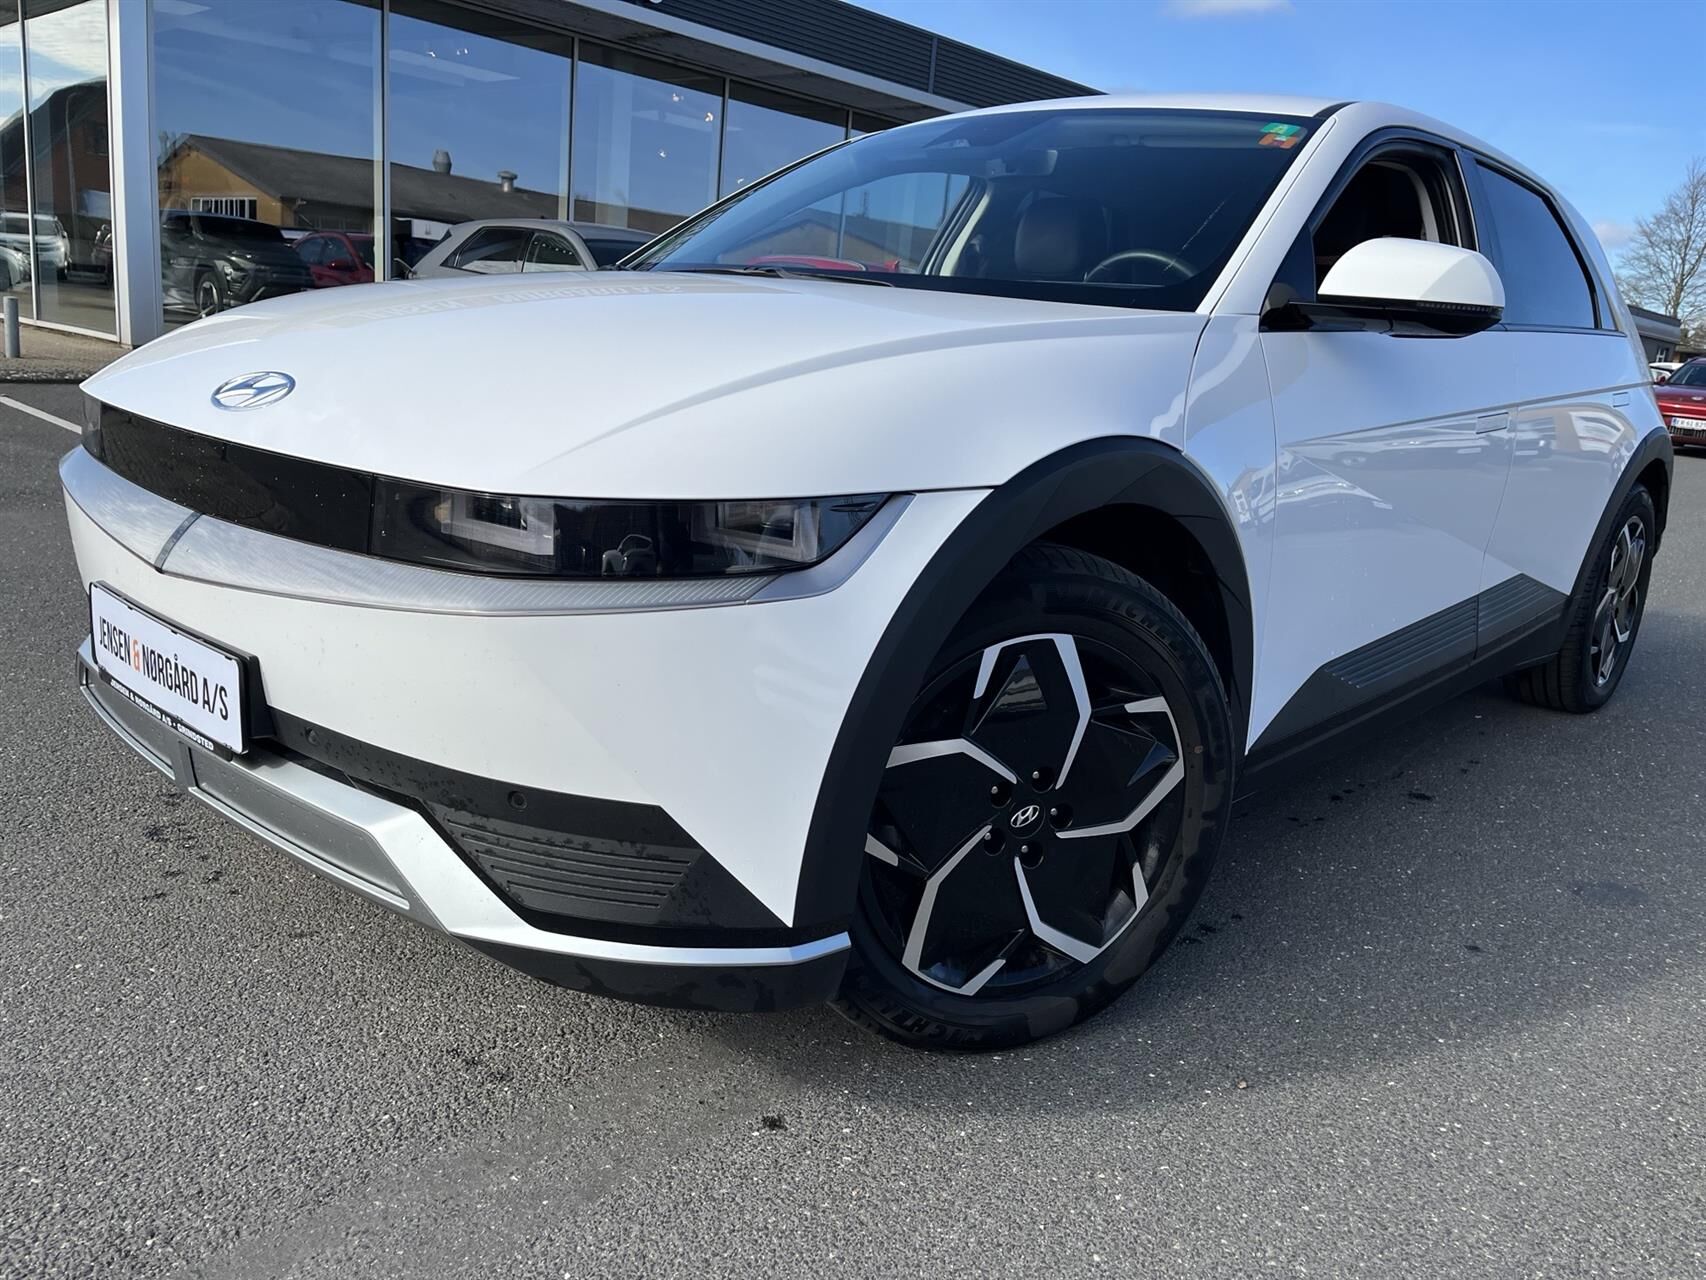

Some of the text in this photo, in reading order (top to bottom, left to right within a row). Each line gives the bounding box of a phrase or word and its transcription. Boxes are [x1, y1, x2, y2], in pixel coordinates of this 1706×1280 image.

[99, 615, 229, 721] JENSEN & NØRGÅRD A/S
